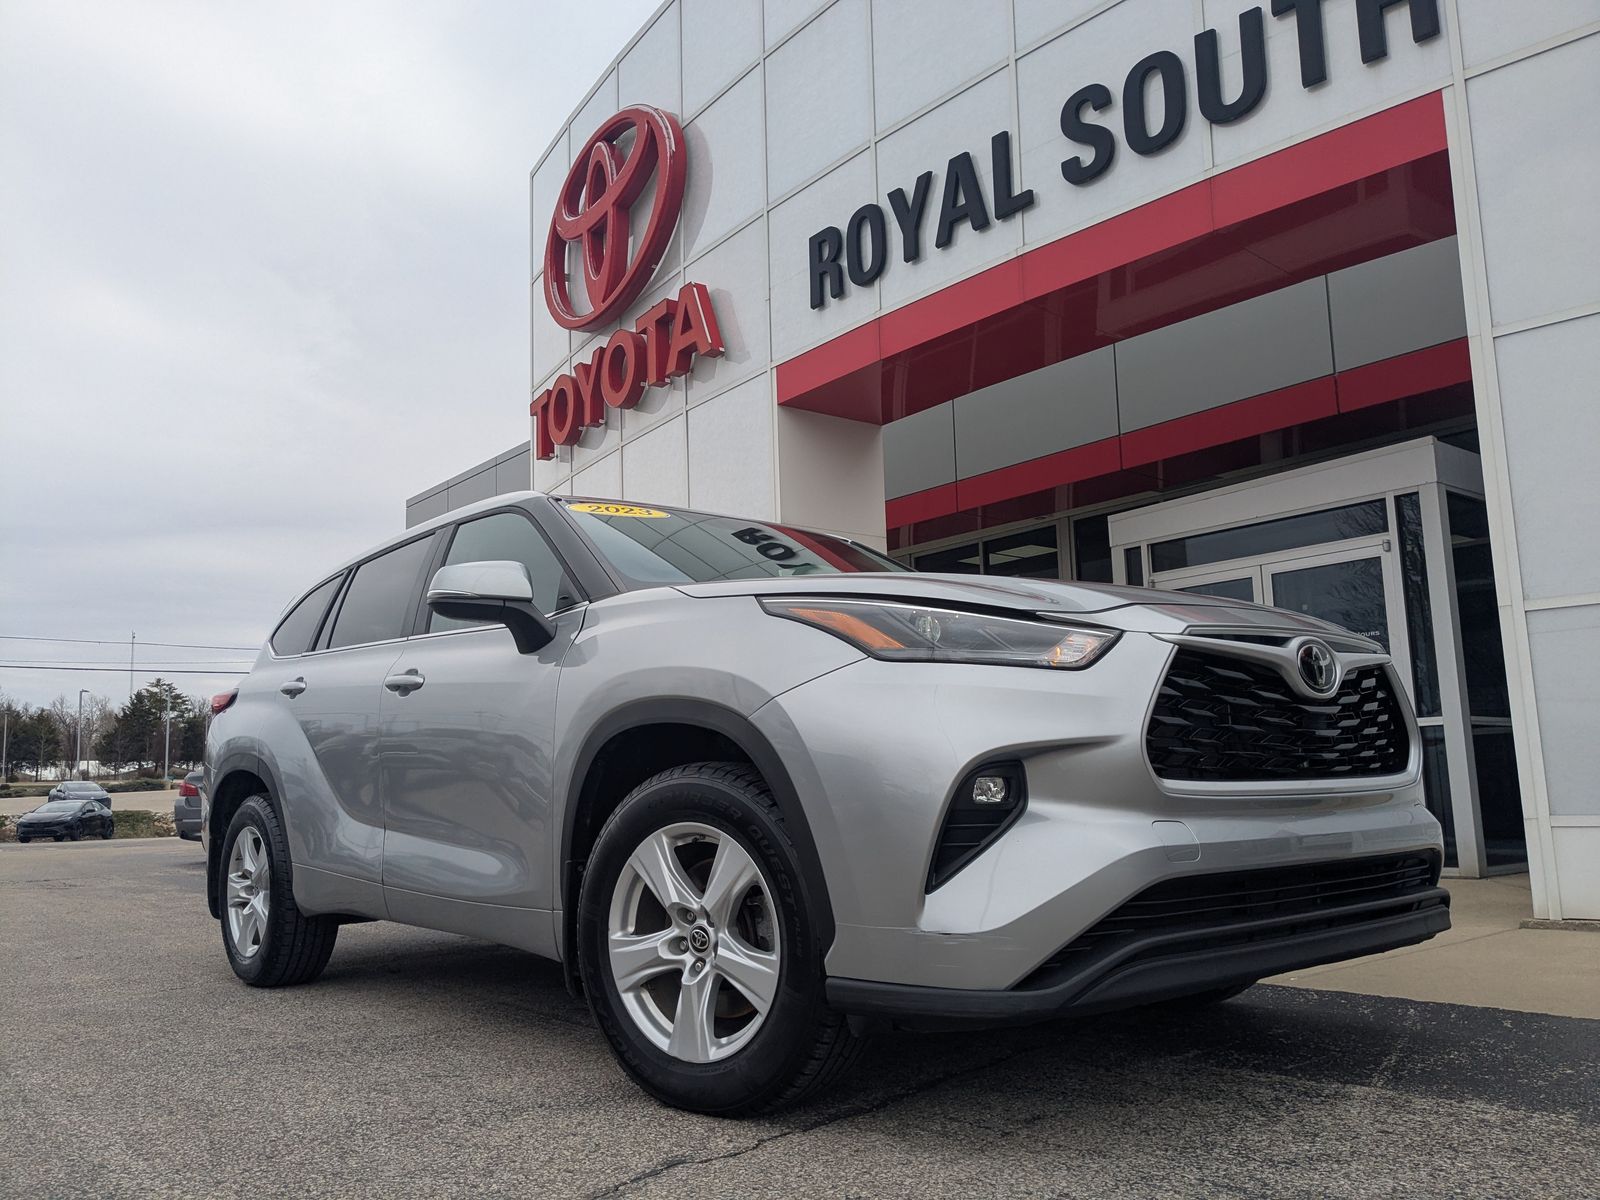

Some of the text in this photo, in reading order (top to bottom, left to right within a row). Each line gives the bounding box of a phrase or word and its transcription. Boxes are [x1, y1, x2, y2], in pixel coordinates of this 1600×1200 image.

[809, 130, 1035, 310] ROYAL
[530, 282, 726, 461] TOYOTA
[587, 505, 653, 516] 2023
